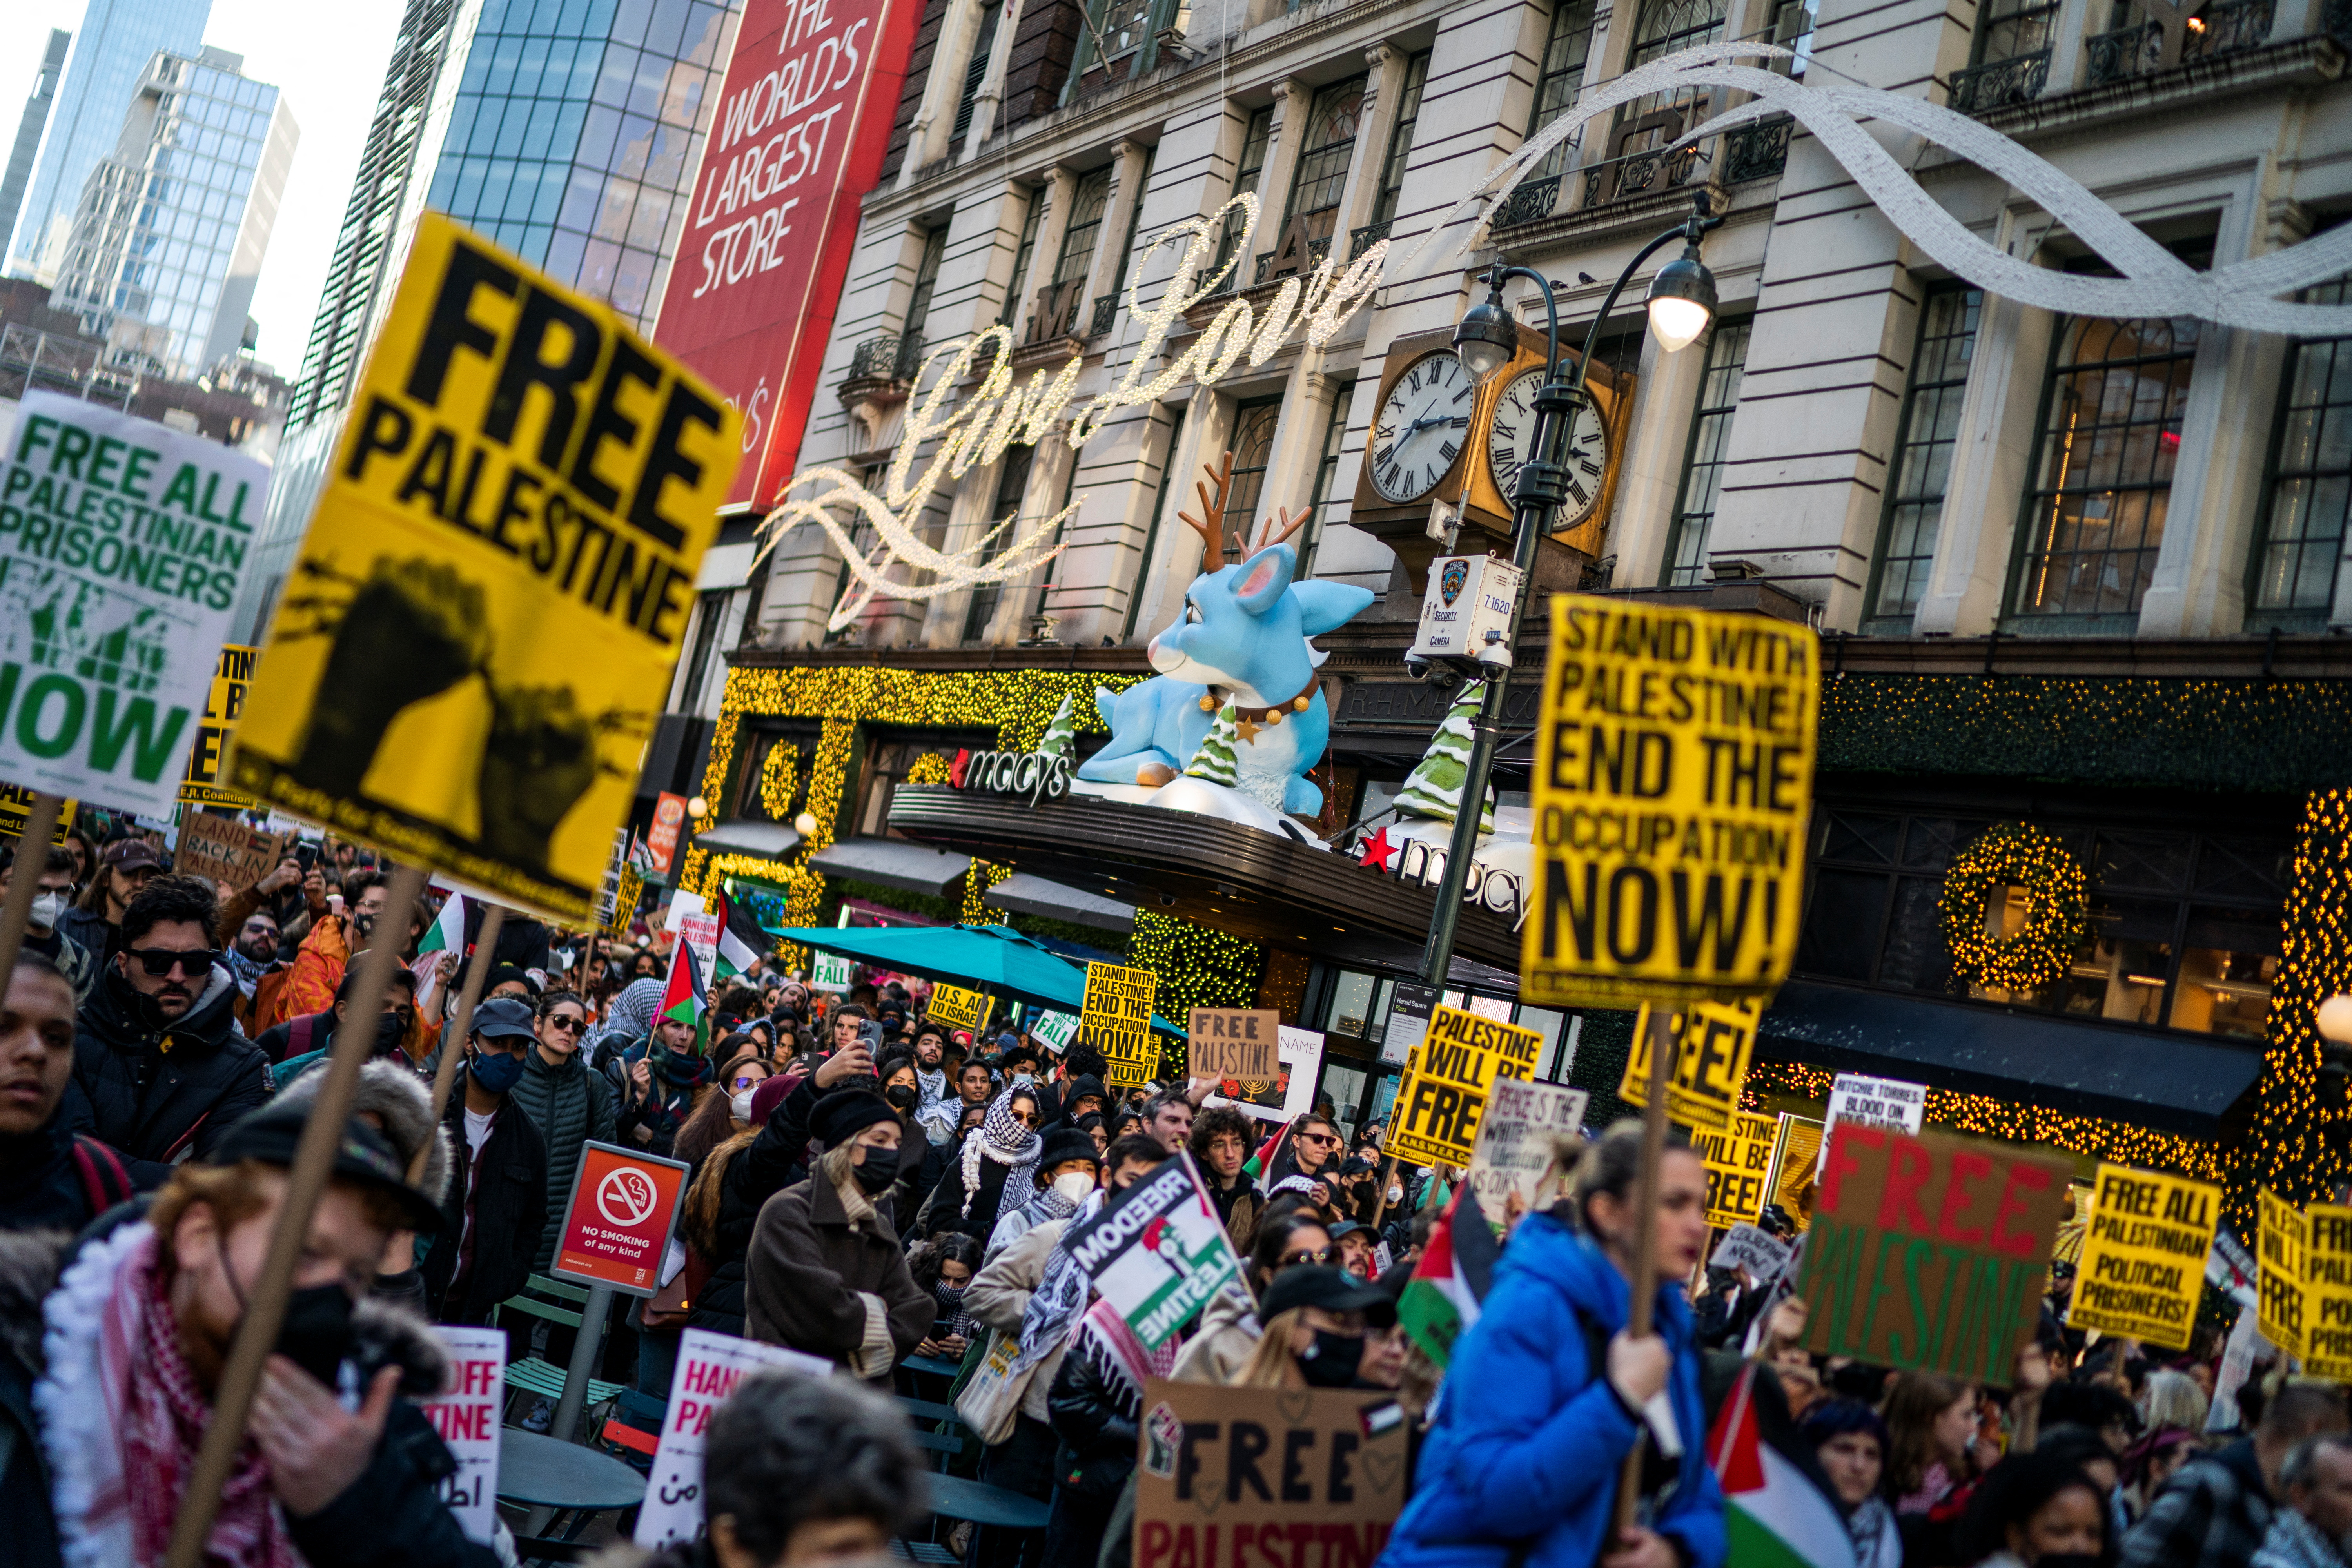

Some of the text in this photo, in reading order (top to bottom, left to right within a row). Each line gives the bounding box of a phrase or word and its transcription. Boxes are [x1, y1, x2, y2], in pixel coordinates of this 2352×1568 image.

[719, 16, 869, 154] WORLD'S
[695, 102, 843, 230] LARGEST
[693, 196, 800, 298] STORE
[406, 239, 722, 552] FREE
[16, 412, 255, 536] FREE ALL
[1, 465, 249, 571] PALESTINIAN
[344, 394, 697, 645] PALESTINE
[1443, 566, 1467, 575] DEPARTMENT
[1485, 594, 1510, 615] 7-1620
[1485, 630, 1501, 639] NYPD
[1564, 606, 1808, 676] STAND WITH
[1556, 660, 1807, 735] PALESTINE!
[1548, 720, 1802, 815] END THE
[202, 788, 251, 804] Coalition
[193, 813, 247, 846] LAND
[274, 813, 297, 826] RIGHT
[1540, 804, 1790, 869] OCCUPATION
[187, 834, 269, 875] BACK IN
[1395, 837, 1531, 933] macy
[681, 918, 707, 932] HANDS
[1540, 858, 1780, 978] NOW!
[815, 965, 846, 985] FALL
[827, 957, 839, 967] WILL
[1090, 964, 1154, 987] STAND WITH
[937, 985, 962, 1007] U.S.
[1089, 977, 1153, 1001] PALESTINE!
[1396, 997, 1428, 1009] Herald Square
[932, 1000, 984, 1027] TO ISRAE
[1053, 1014, 1066, 1029] WILL
[1085, 991, 1151, 1021] END THE
[1395, 1004, 1407, 1013] Plaza
[1035, 1016, 1068, 1048] FALL
[1083, 1013, 1148, 1034] OCCUPATION
[1195, 1013, 1259, 1040] FREE
[1432, 1010, 1542, 1063] PALESTINE
[1081, 1025, 1144, 1061] NOW!
[1194, 1041, 1270, 1076] PALESTINE
[1279, 1035, 1317, 1055] NAME
[1424, 1037, 1485, 1089] WILL
[1405, 1080, 1483, 1149] FRE
[1846, 1096, 1905, 1118] BLOOD ON
[1734, 1117, 1778, 1143] STINE
[1404, 1149, 1432, 1163] Coalition
[1745, 1142, 1772, 1171] BE
[1818, 1122, 2054, 1259] FREE
[2098, 1175, 2211, 1231] FREE ALL
[582, 1225, 650, 1249] NO SMOKING
[584, 1239, 642, 1259] of any kind
[2090, 1214, 2210, 1261] PALESTINIAN
[2094, 1254, 2186, 1293] POLITICAL
[1797, 1213, 2047, 1387] PALESTINE
[1175, 1419, 1359, 1504] FREE
